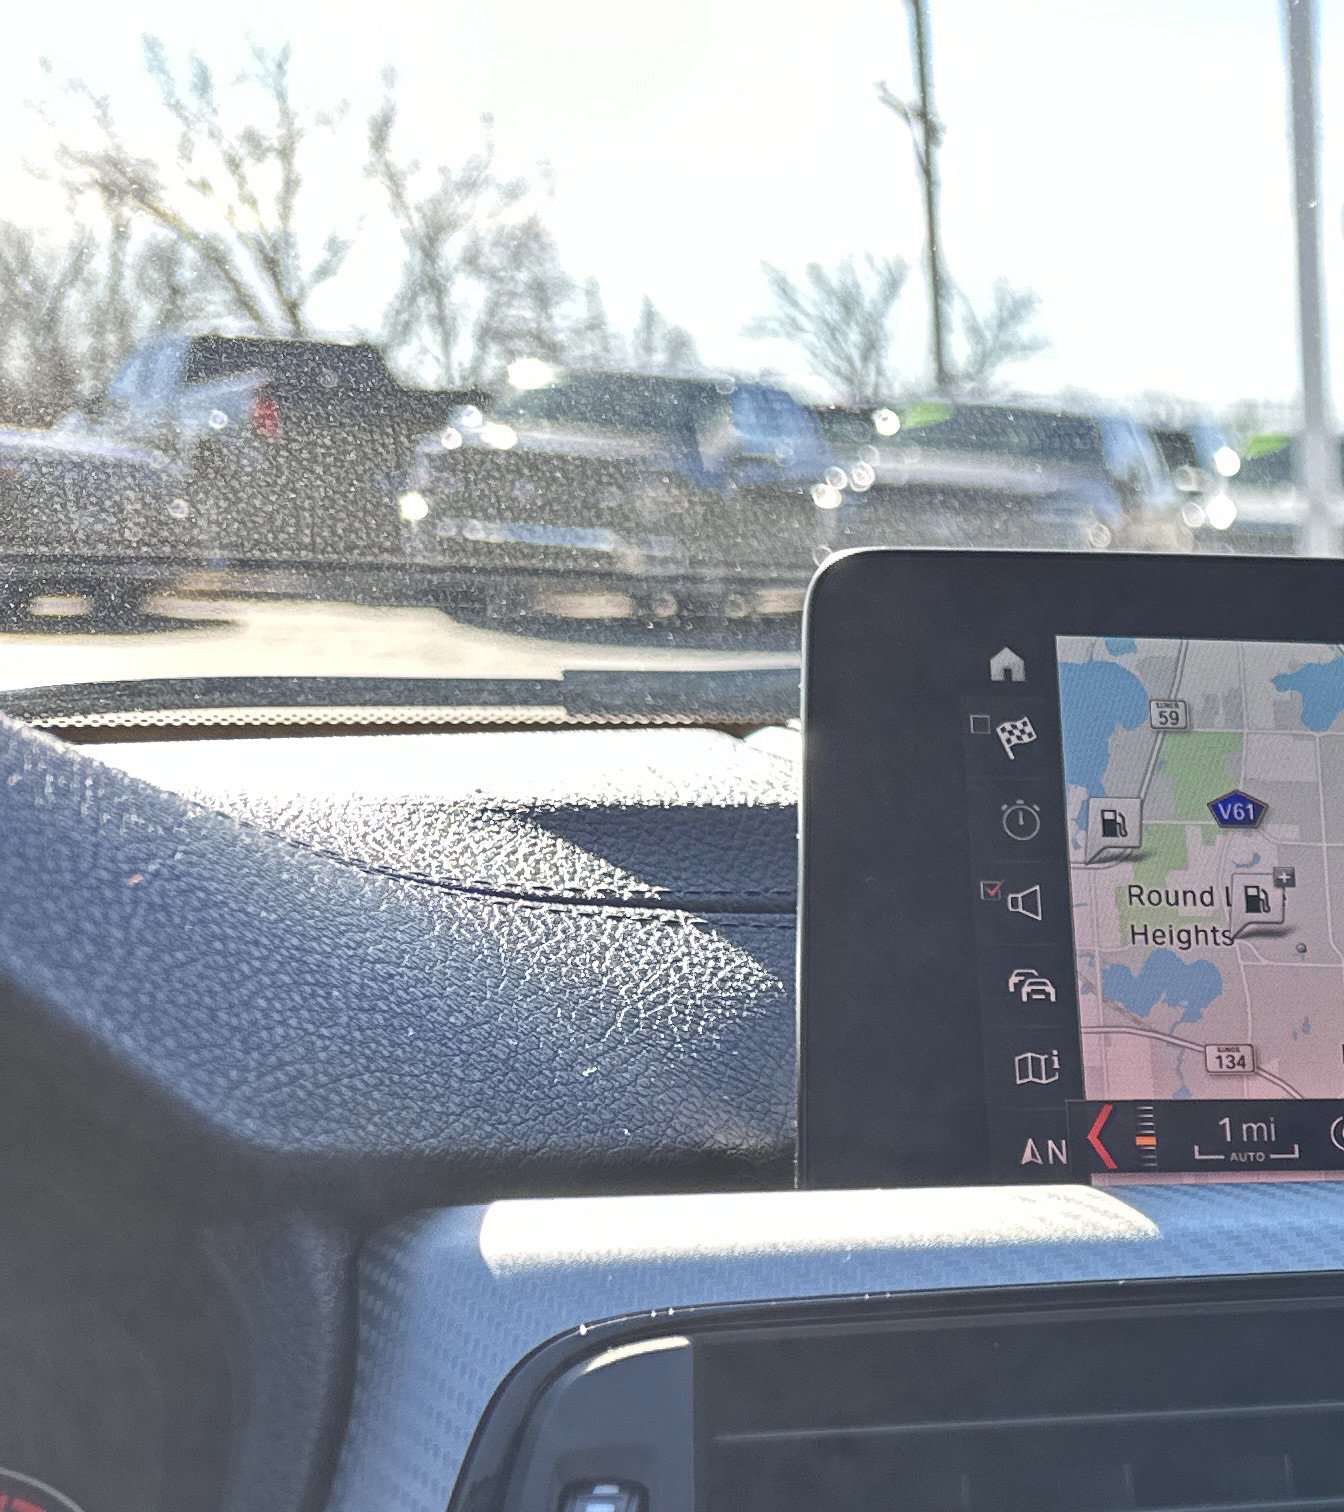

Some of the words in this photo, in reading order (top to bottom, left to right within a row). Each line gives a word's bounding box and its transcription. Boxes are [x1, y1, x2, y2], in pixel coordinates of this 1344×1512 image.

[1159, 710, 1179, 726] 59
[1218, 803, 1254, 821] V61
[1127, 884, 1214, 907] Round
[1130, 924, 1235, 950] Heights
[1216, 1055, 1246, 1069] 134
[1217, 1117, 1231, 1142] 1
[1242, 1117, 1276, 1142] mi
[1229, 1151, 1266, 1163] AUTO
